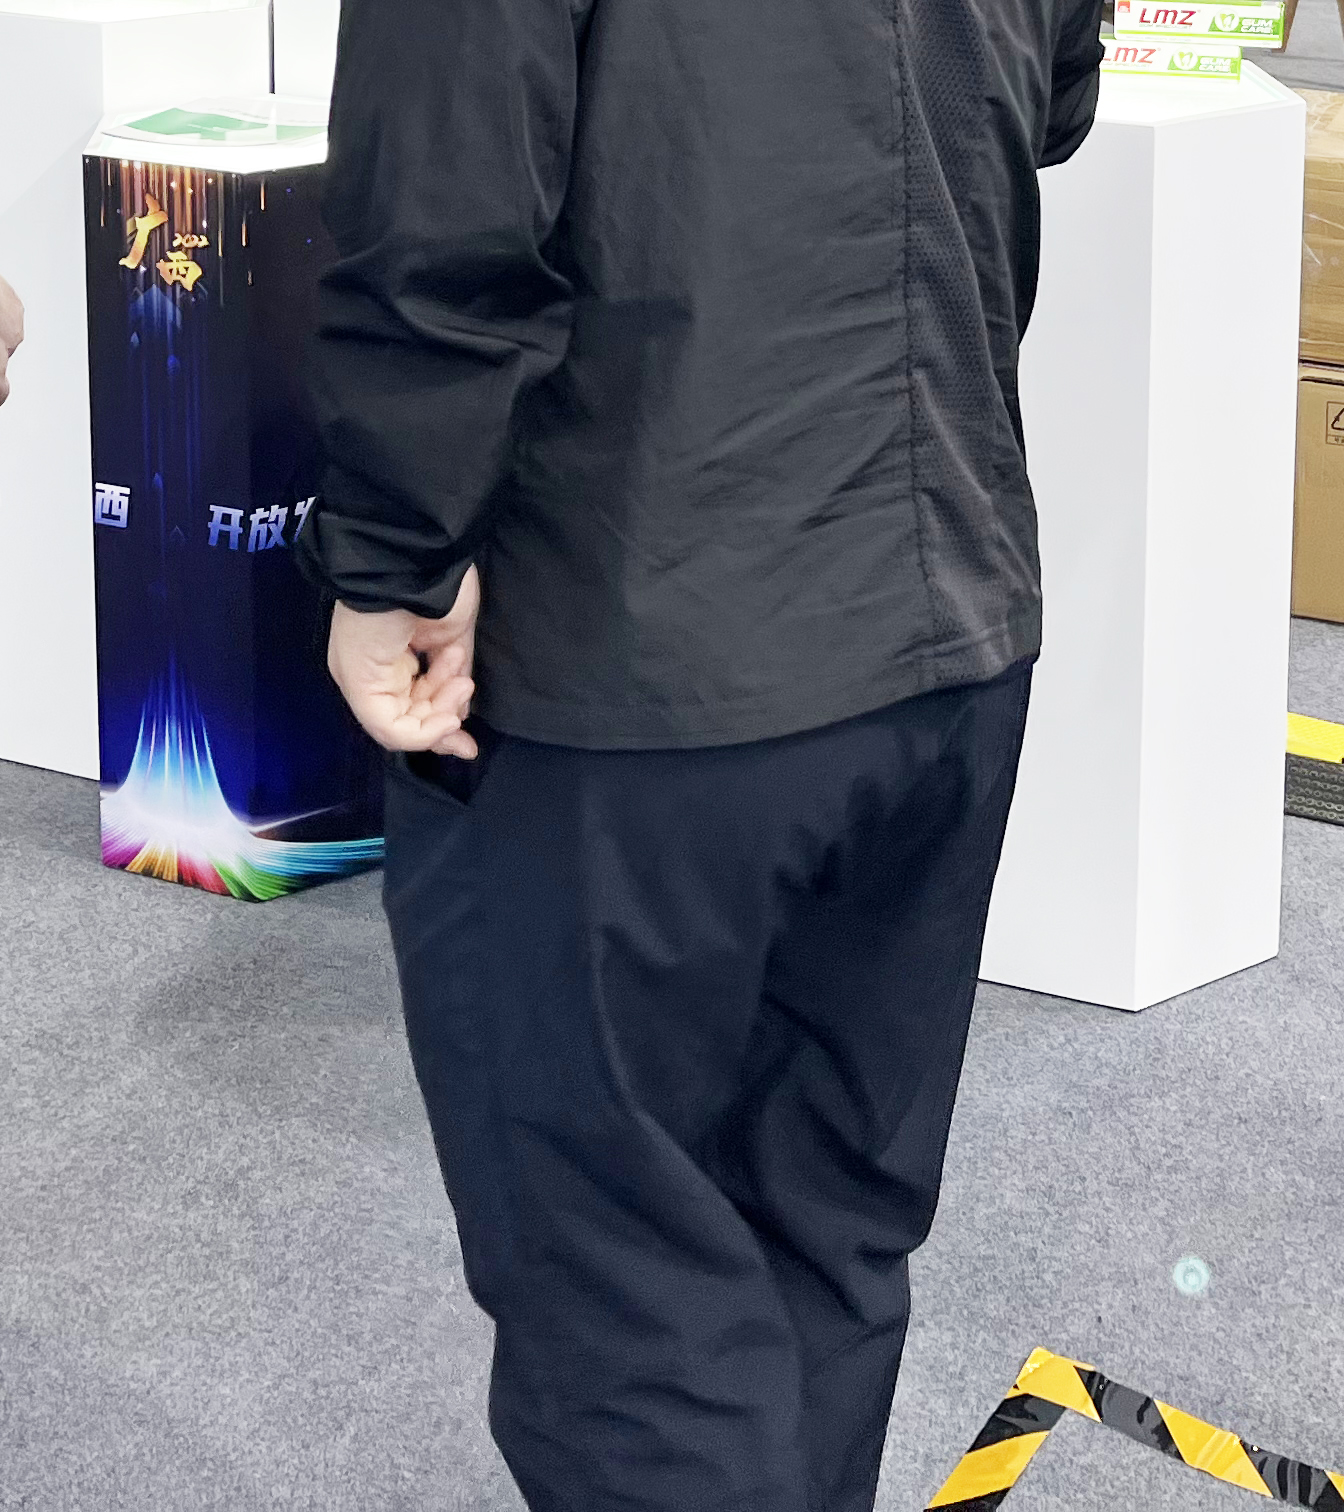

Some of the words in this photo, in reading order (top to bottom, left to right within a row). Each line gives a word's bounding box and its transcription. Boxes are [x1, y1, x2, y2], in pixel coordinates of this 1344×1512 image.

[1139, 8, 1197, 26] LMZ
[118, 192, 203, 292] 广西
[94, 482, 131, 529] 西
